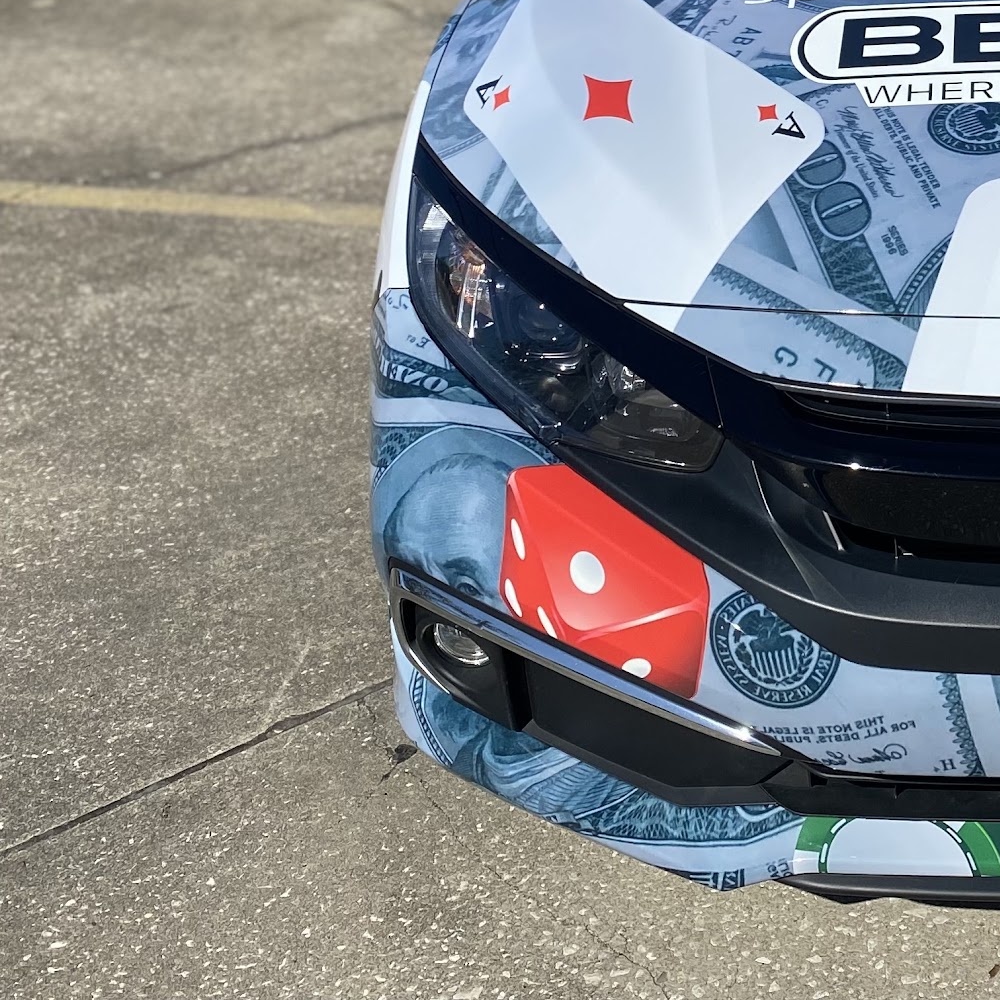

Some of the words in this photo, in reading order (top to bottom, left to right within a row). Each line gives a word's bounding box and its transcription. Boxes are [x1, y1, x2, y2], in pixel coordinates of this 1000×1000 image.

[475, 75, 503, 110] A
[771, 110, 806, 140] A
[890, 117, 907, 135] NOTE
[901, 133, 911, 142] IS
[905, 141, 923, 163] LEGAL
[894, 140, 915, 164] PUBLIC
[907, 163, 923, 179] AND
[918, 179, 942, 209] PRIVATE
[919, 161, 941, 190] TENDER
[888, 225, 909, 257] SERIES
